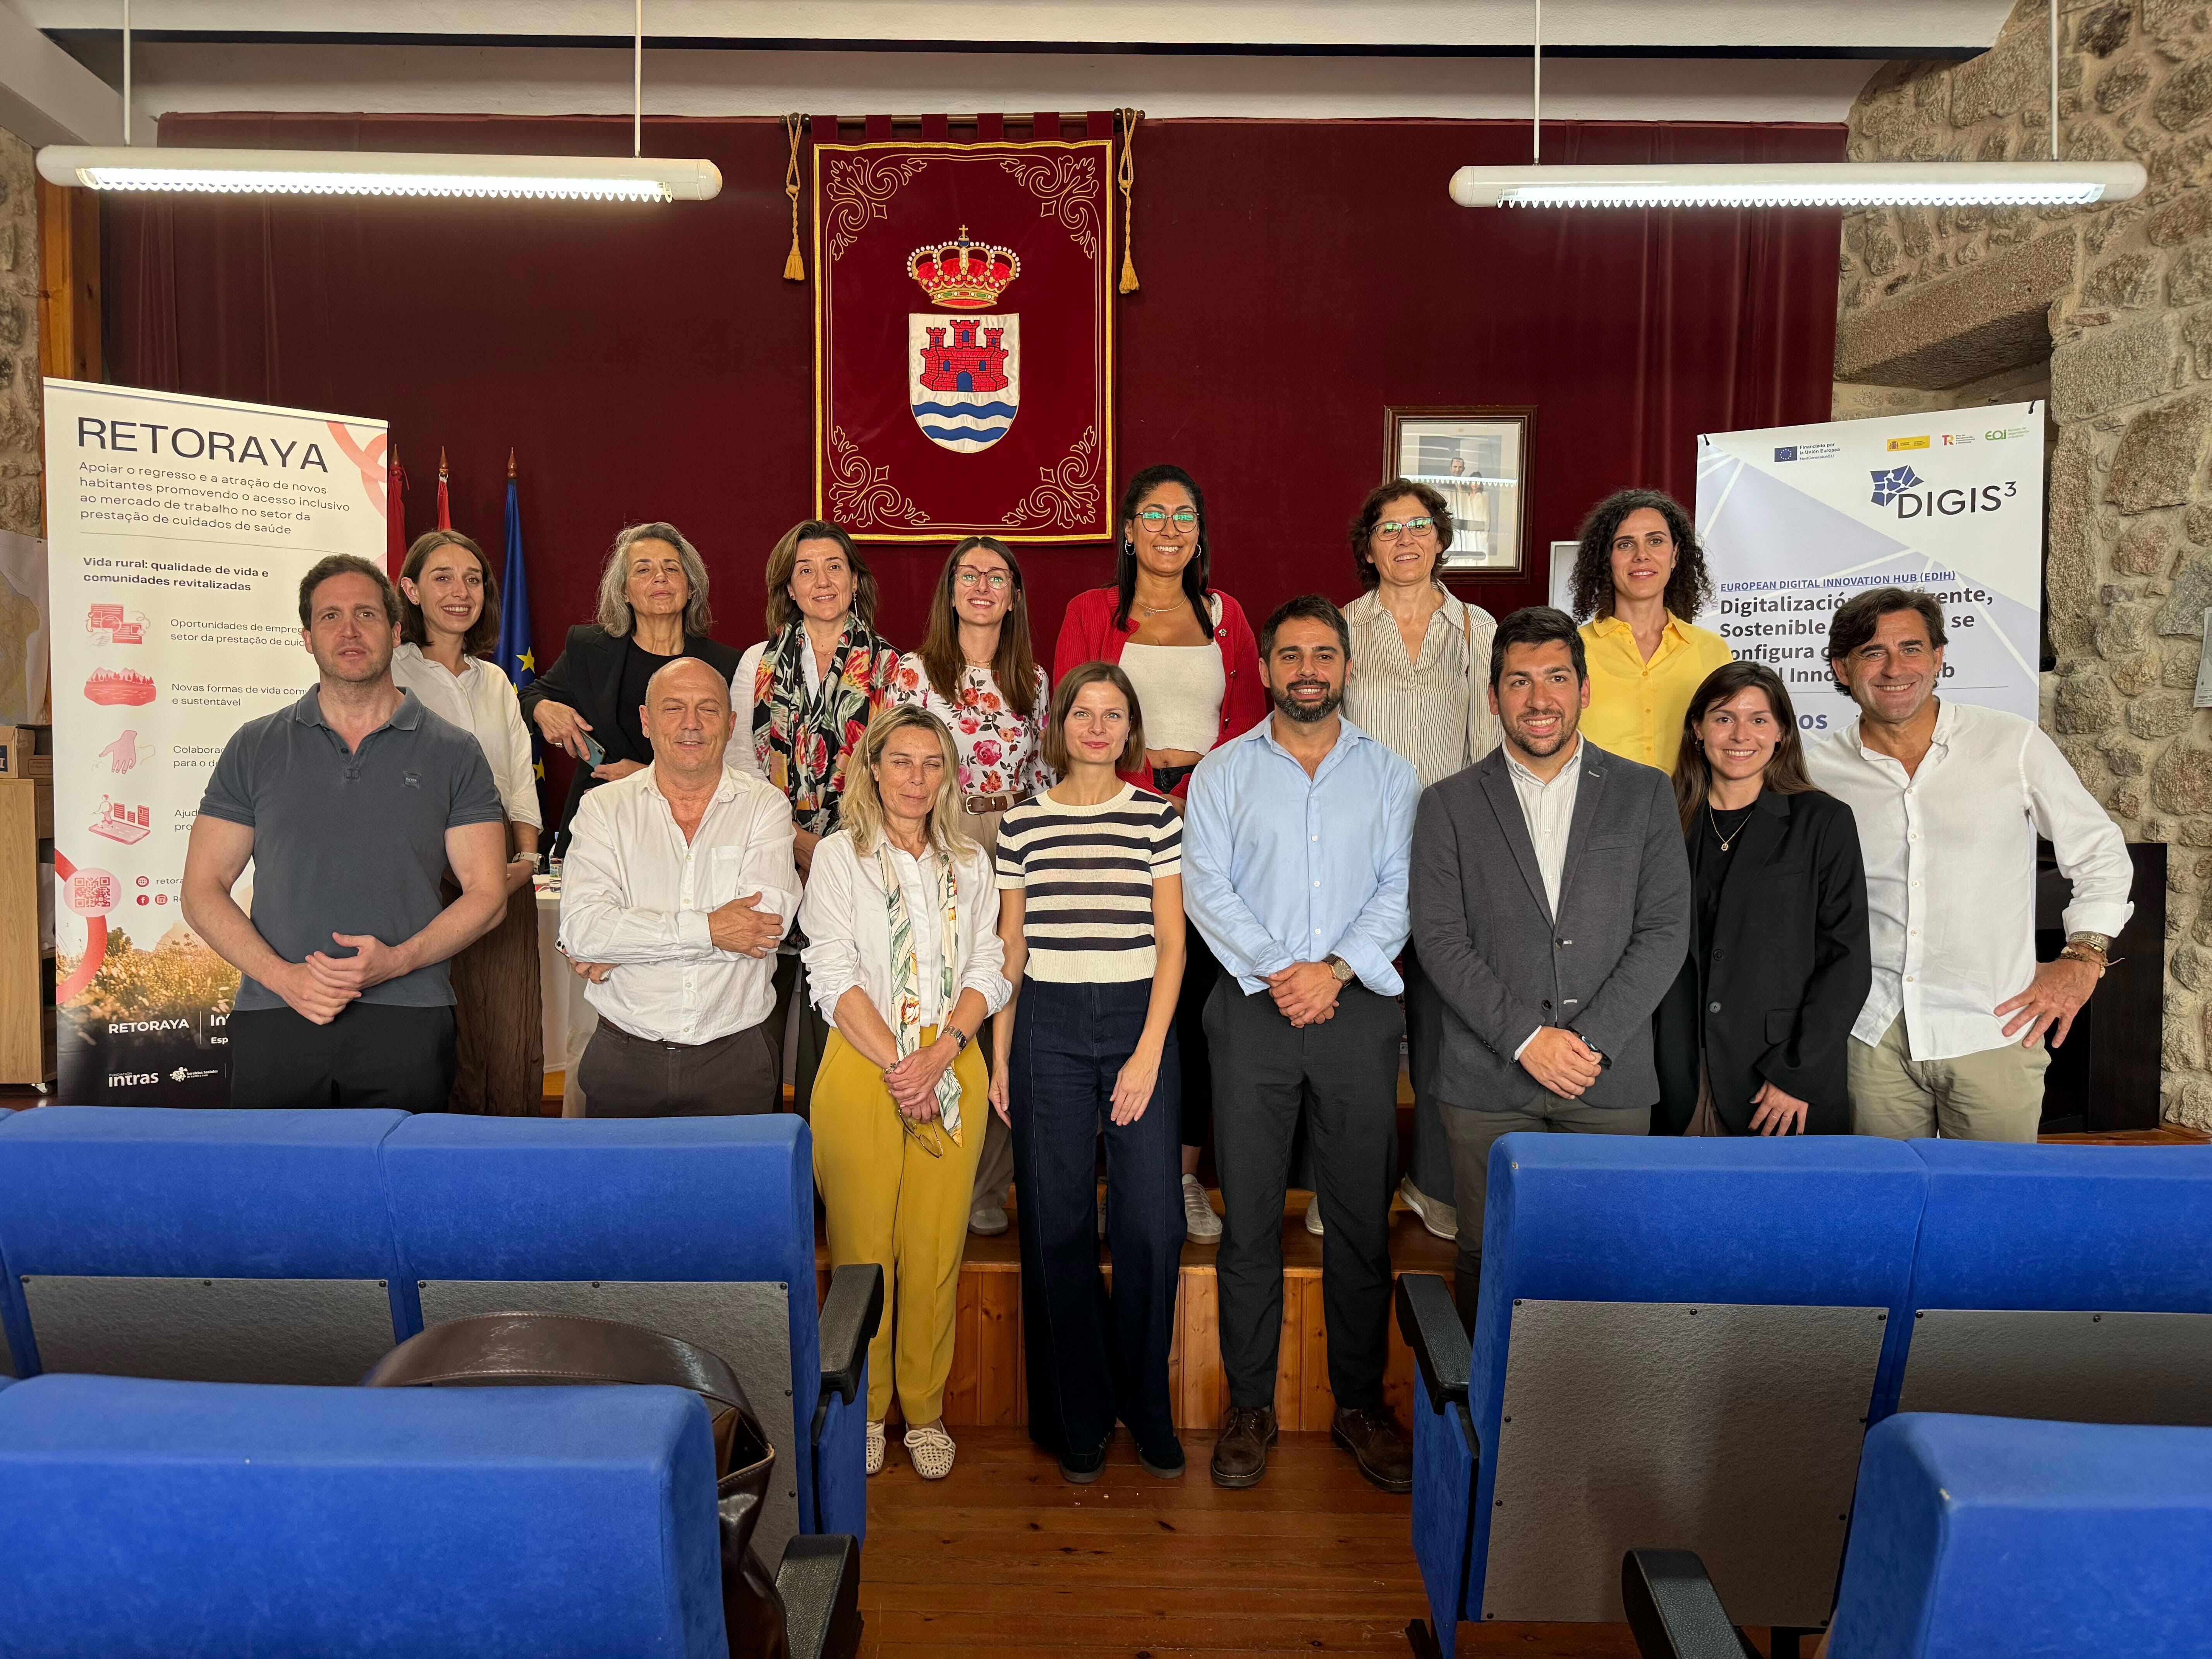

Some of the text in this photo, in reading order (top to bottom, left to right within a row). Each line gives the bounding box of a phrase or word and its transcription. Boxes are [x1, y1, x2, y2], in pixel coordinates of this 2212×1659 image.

[78, 416, 329, 473] RETORAYA
[79, 462, 123, 473] Apoiar
[139, 469, 196, 480] regresso
[222, 477, 270, 489] atração
[273, 480, 289, 489] de
[292, 484, 326, 494] novos
[80, 477, 152, 491] habitantes
[156, 486, 238, 500] promovendo
[253, 495, 296, 505] acesso
[299, 497, 350, 511] inclusivo
[101, 497, 160, 507] mercado
[164, 500, 180, 509] de
[184, 502, 238, 514] trabalho
[260, 510, 292, 519] setor
[295, 512, 310, 521] da
[81, 511, 291, 534] prestação de cuidados de saúde
[83, 557, 112, 567] Vida
[116, 560, 148, 568] rural:
[151, 562, 211, 573] qualidade
[215, 565, 230, 574] de
[234, 567, 258, 576] vida
[83, 574, 251, 591] comunidades revitalizadas
[1721, 570, 1955, 591] EUROPEAN DIGITAL INNOVATION HUB (EDIH)
[1721, 588, 1994, 617] Digitalizació ente,
[170, 619, 248, 630] Oportunidades
[251, 623, 263, 631] de
[1720, 615, 1975, 638] Sostenible se
[216, 636, 267, 645] prestação
[172, 684, 204, 692] Novas
[207, 684, 243, 693] formas
[175, 809, 198, 819] Ajud
[108, 1018, 189, 1034] RETORAYA
[108, 1072, 159, 1087] intras
